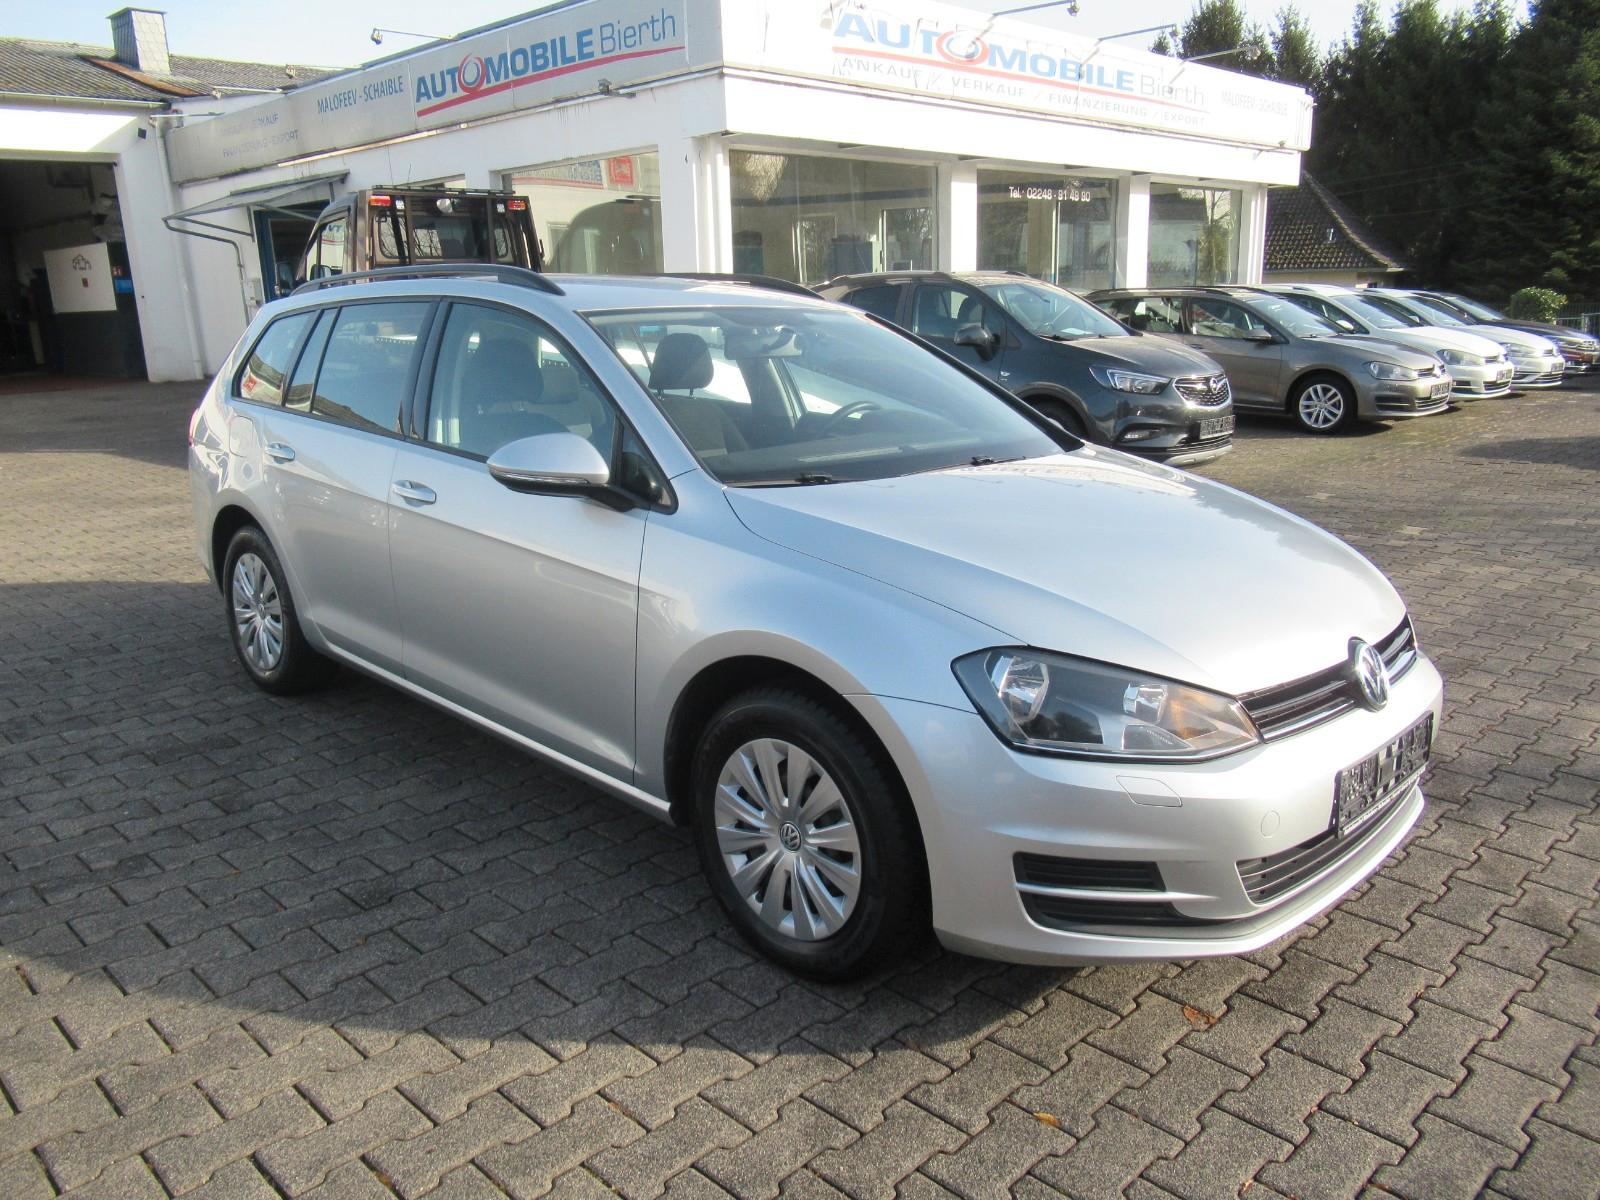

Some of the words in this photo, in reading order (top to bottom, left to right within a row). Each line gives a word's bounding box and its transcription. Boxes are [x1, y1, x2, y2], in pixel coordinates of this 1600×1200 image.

[415, 28, 594, 103] AUTOMOBILE
[600, 8, 676, 54] Bierth
[833, 12, 1134, 92] AUTOMOBILE
[1140, 74, 1205, 106] Bierth
[317, 89, 357, 114] MALOFEEV
[363, 75, 404, 103] SCHAIBLE
[842, 57, 923, 80] ANKAUF
[951, 77, 1025, 97] VERKAUF
[1048, 93, 1148, 118] FINANZIERUNG
[1163, 111, 1205, 126] EXPORT
[1026, 187, 1053, 200] 02248
